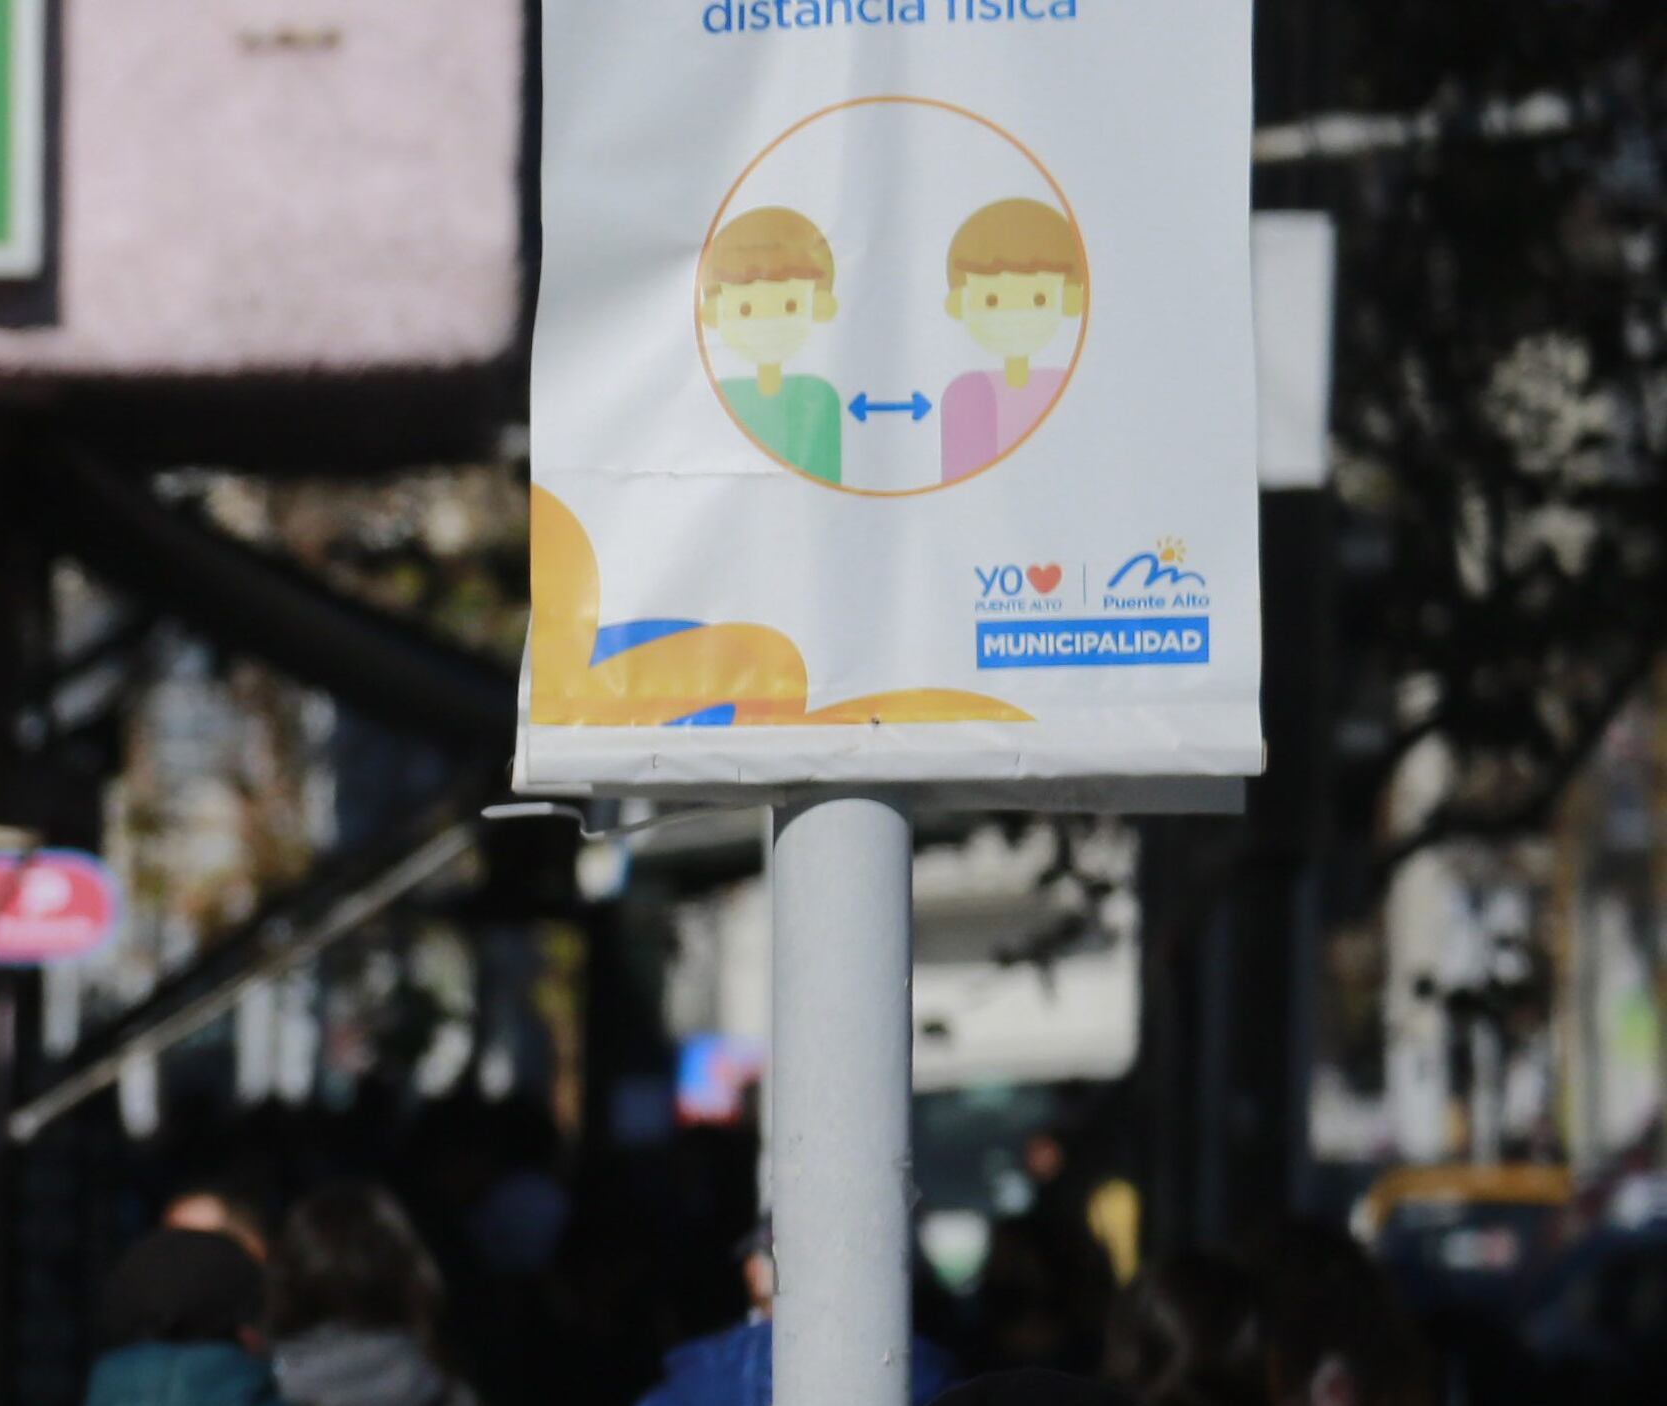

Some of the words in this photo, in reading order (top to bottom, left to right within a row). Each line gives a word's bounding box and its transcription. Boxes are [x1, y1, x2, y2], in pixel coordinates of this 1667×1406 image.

[702, 0, 926, 34] distancia
[1103, 595, 1165, 610] Puente
[1172, 592, 1210, 608] Alto
[983, 629, 1202, 658] MUNICIPALIDAD
